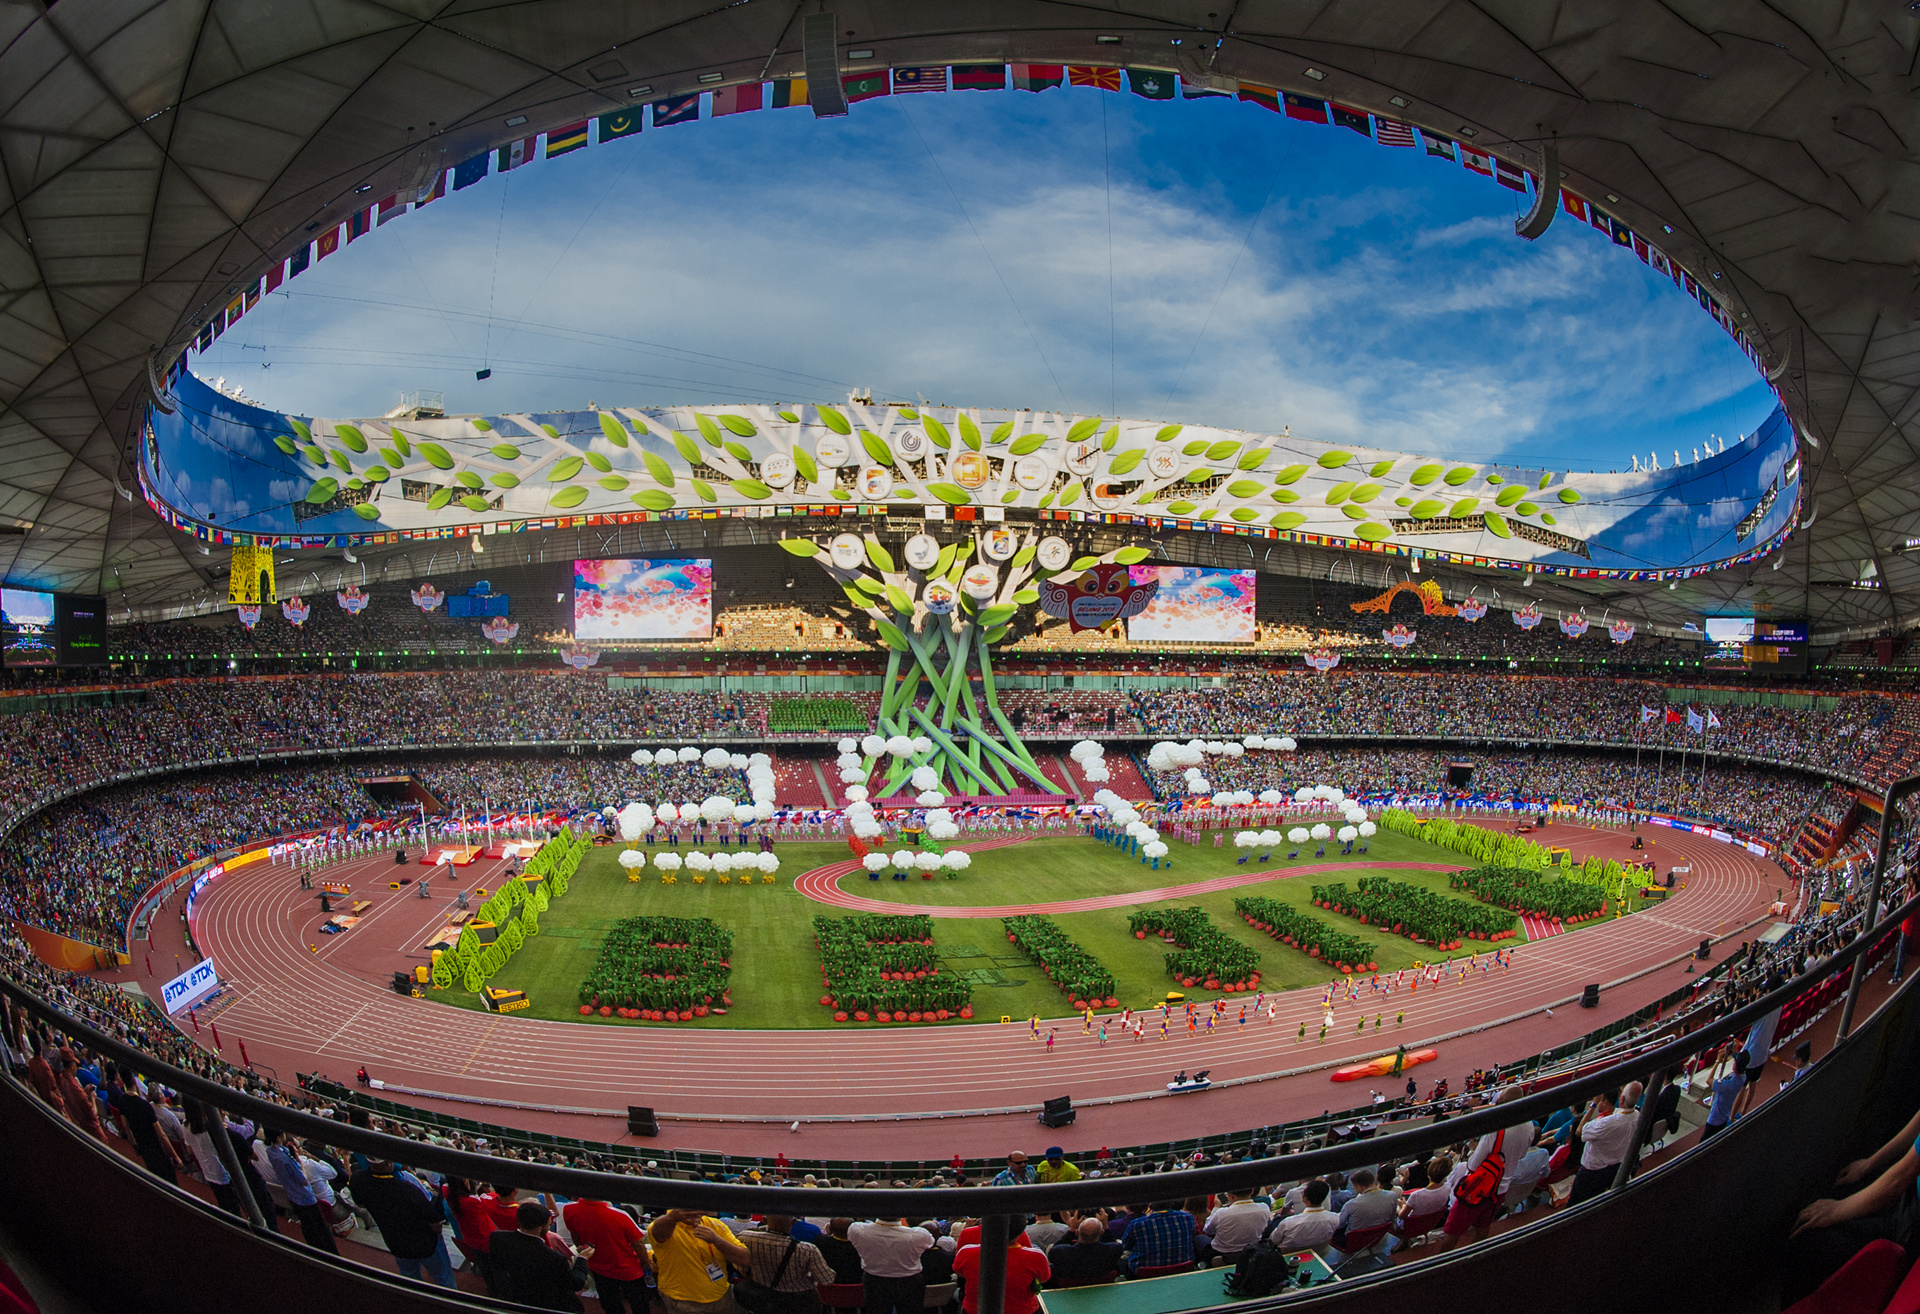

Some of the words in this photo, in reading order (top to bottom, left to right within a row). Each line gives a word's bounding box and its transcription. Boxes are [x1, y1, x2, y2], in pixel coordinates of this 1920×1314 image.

[169, 977, 190, 999] TDK
[194, 962, 214, 983] TDK
[501, 1000, 528, 1012] SEIKO
